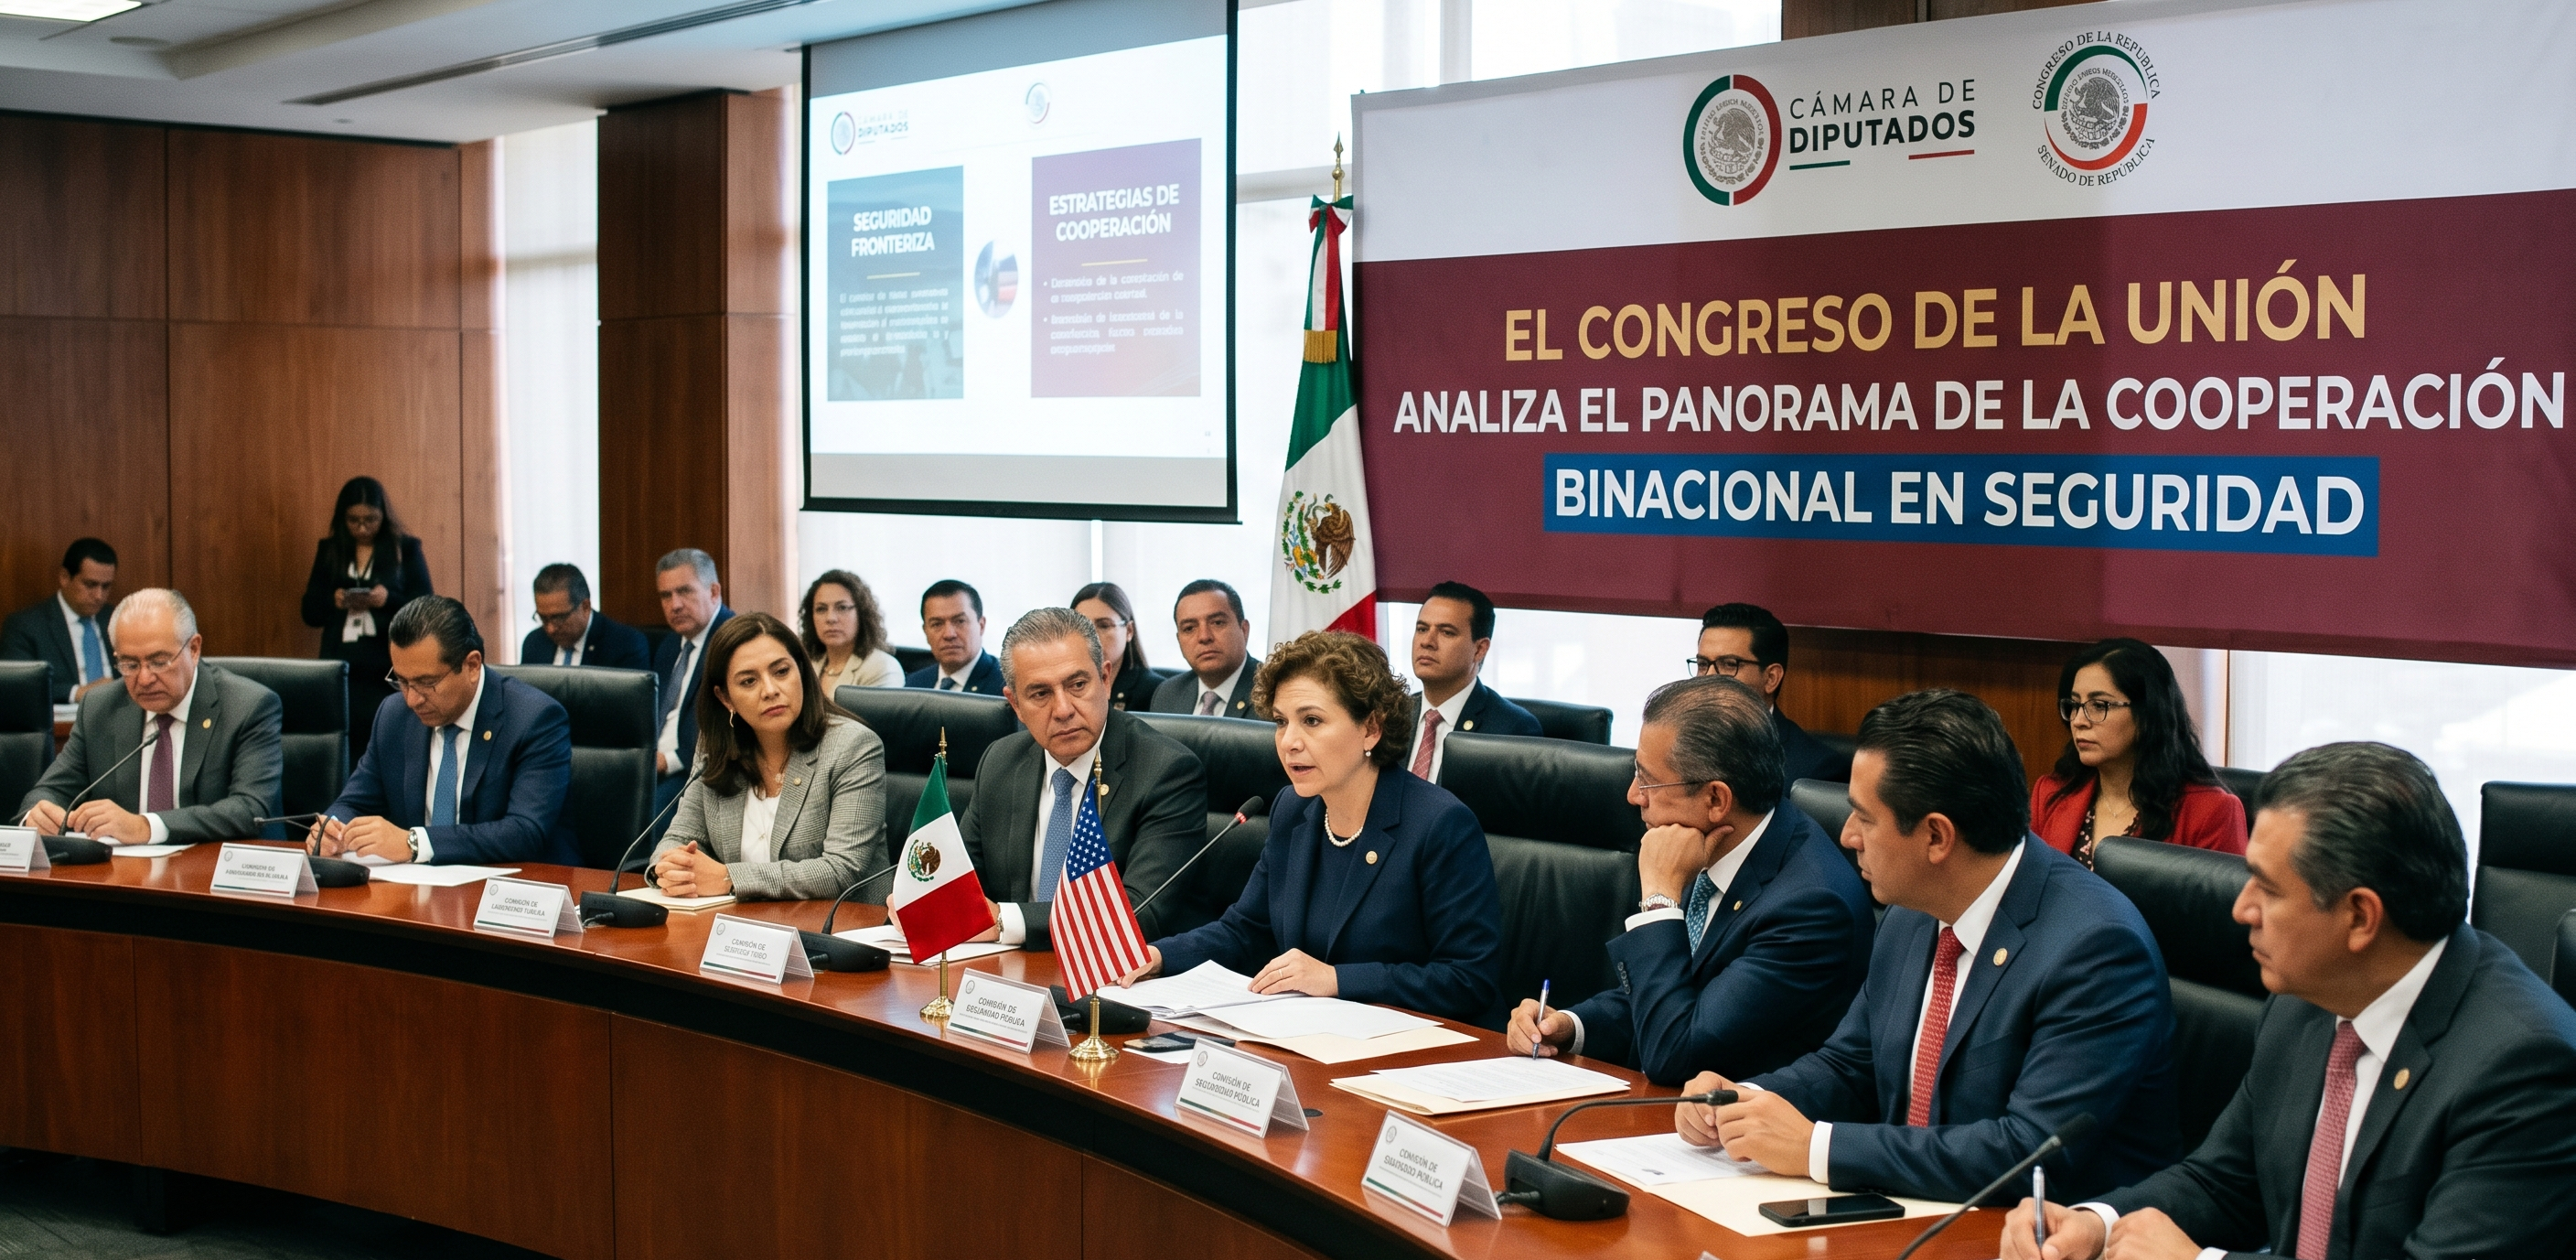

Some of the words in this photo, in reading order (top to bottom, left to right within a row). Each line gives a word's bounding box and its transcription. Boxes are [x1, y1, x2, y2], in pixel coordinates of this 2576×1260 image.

[2033, 40, 2074, 109] CONGRESO
[2077, 32, 2093, 46] DE
[2097, 31, 2111, 42] LA
[1789, 86, 1918, 119] CÁMARA
[1938, 79, 1975, 103] DE
[858, 121, 908, 137] DIPUTADOS
[1789, 110, 1975, 154] DIPUTADOS
[2038, 145, 2076, 183] SENADO
[2078, 175, 2094, 186] DE
[853, 206, 932, 232] SEGURIDAD
[1049, 186, 1153, 216] ESTRATEGIAS
[1156, 183, 1180, 206] DE
[851, 232, 935, 257] FRONTERIZA
[1056, 209, 1172, 242] COOPERACIÓN
[1506, 309, 1562, 361] EL
[1579, 293, 1892, 360] CONGRESO
[1916, 288, 1998, 350] DE
[2022, 285, 2105, 347] LA
[2128, 260, 2366, 344] UNIÓN
[1393, 389, 1567, 433] ANALIZA
[1580, 388, 1628, 432] EL
[1643, 382, 1918, 432] PANORAMA
[1936, 380, 2003, 430] DE
[2023, 379, 2090, 430] LA
[2107, 357, 2564, 430] COOPERACIÓN
[1556, 469, 1873, 523] BINACIONAL
[1891, 471, 1963, 525] EN
[1984, 471, 2365, 535] SEGURIDAD
[1242, 1082, 1251, 1092] DE
